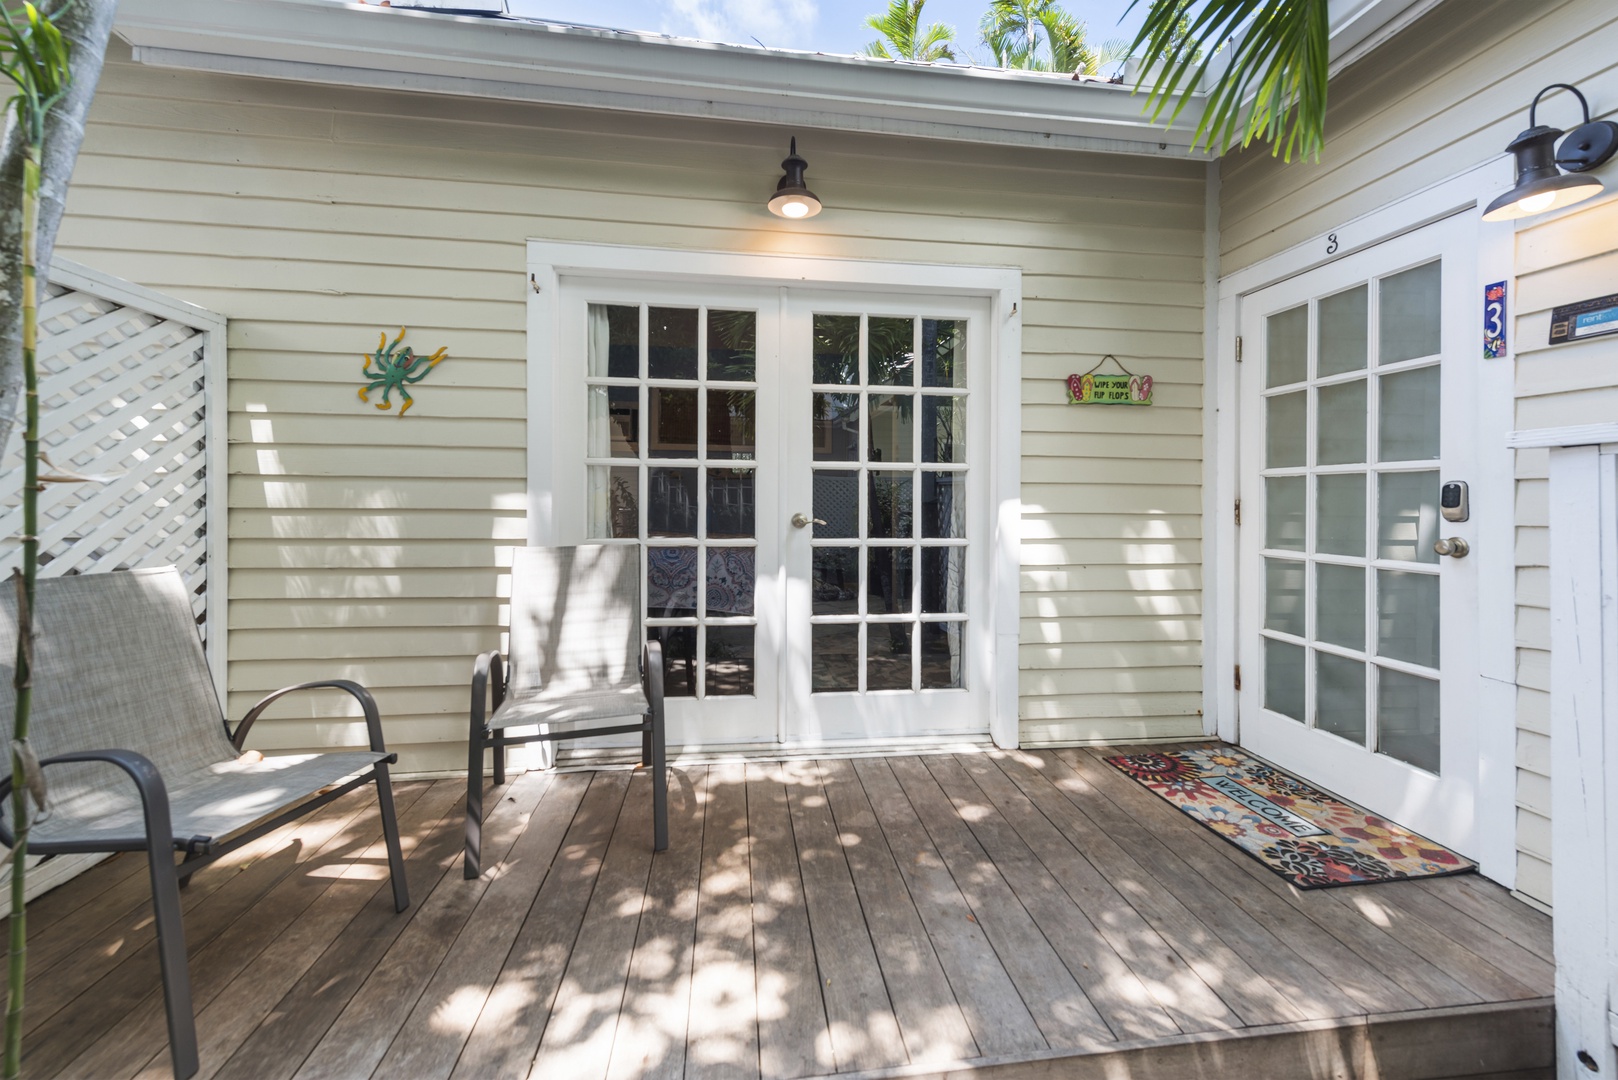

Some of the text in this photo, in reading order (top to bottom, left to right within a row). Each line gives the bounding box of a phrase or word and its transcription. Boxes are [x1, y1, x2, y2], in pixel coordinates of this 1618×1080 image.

[1326, 233, 1339, 255] 3
[1487, 302, 1502, 338] 3
[1094, 381, 1128, 389] WIPE YOUR
[1094, 391, 1129, 400] FLIP FLOPS
[1215, 780, 1312, 833] WELCOME
